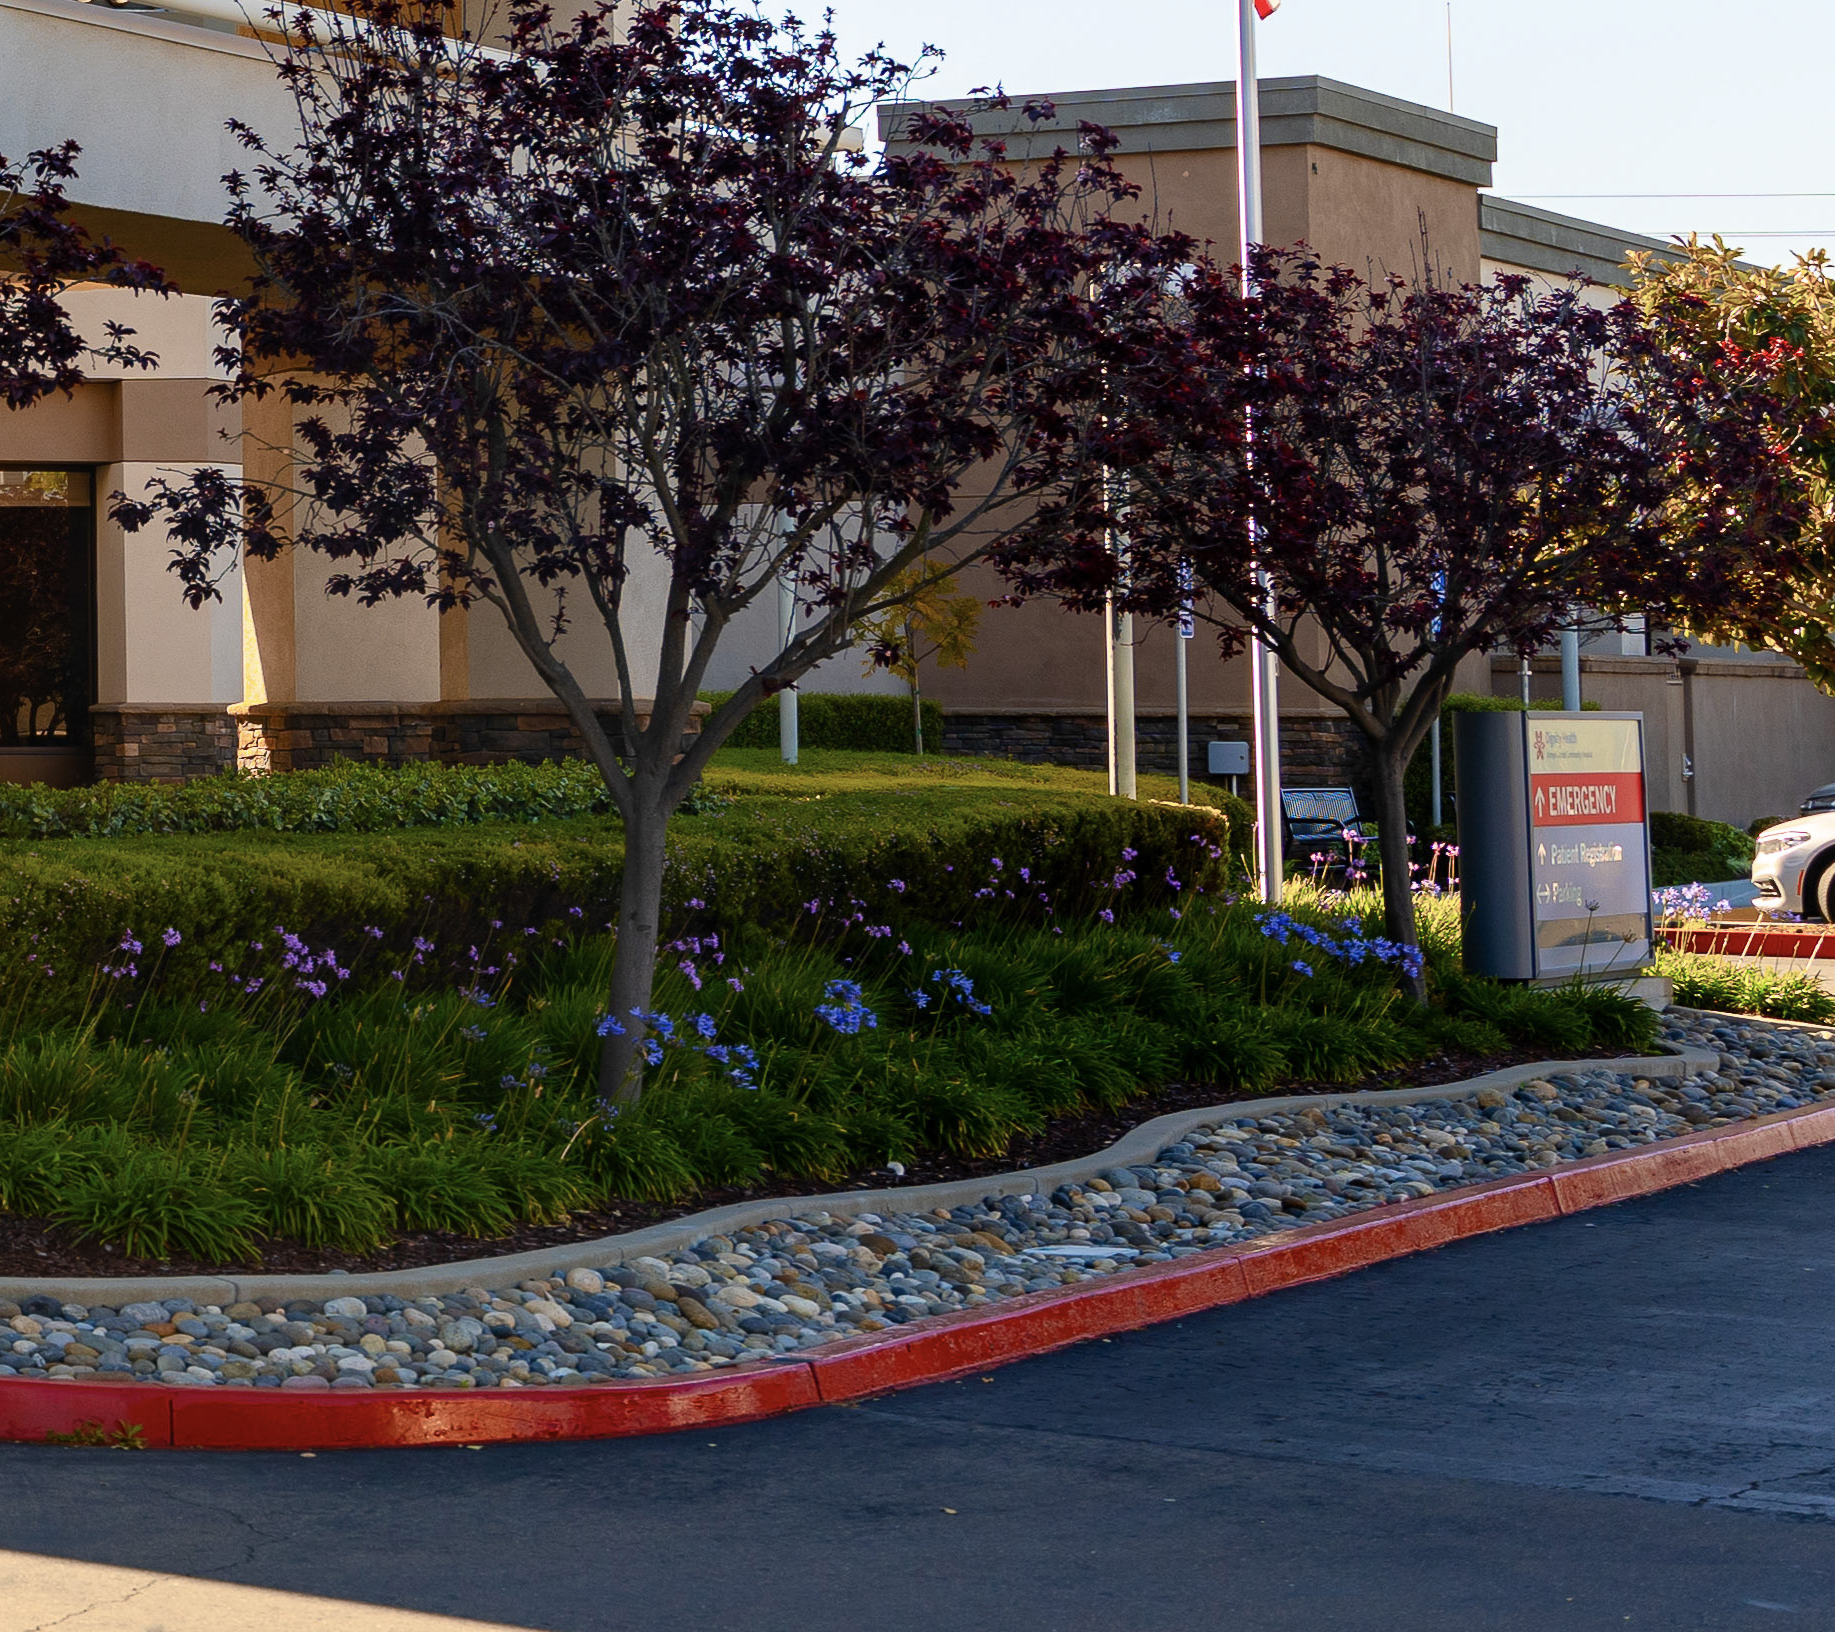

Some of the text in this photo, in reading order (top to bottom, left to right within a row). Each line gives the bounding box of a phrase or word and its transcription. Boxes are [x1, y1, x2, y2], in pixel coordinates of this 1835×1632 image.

[1548, 785, 1616, 816] EMERGENCY
[1551, 843, 1579, 865] Patient
[1552, 882, 1583, 907] Parking
